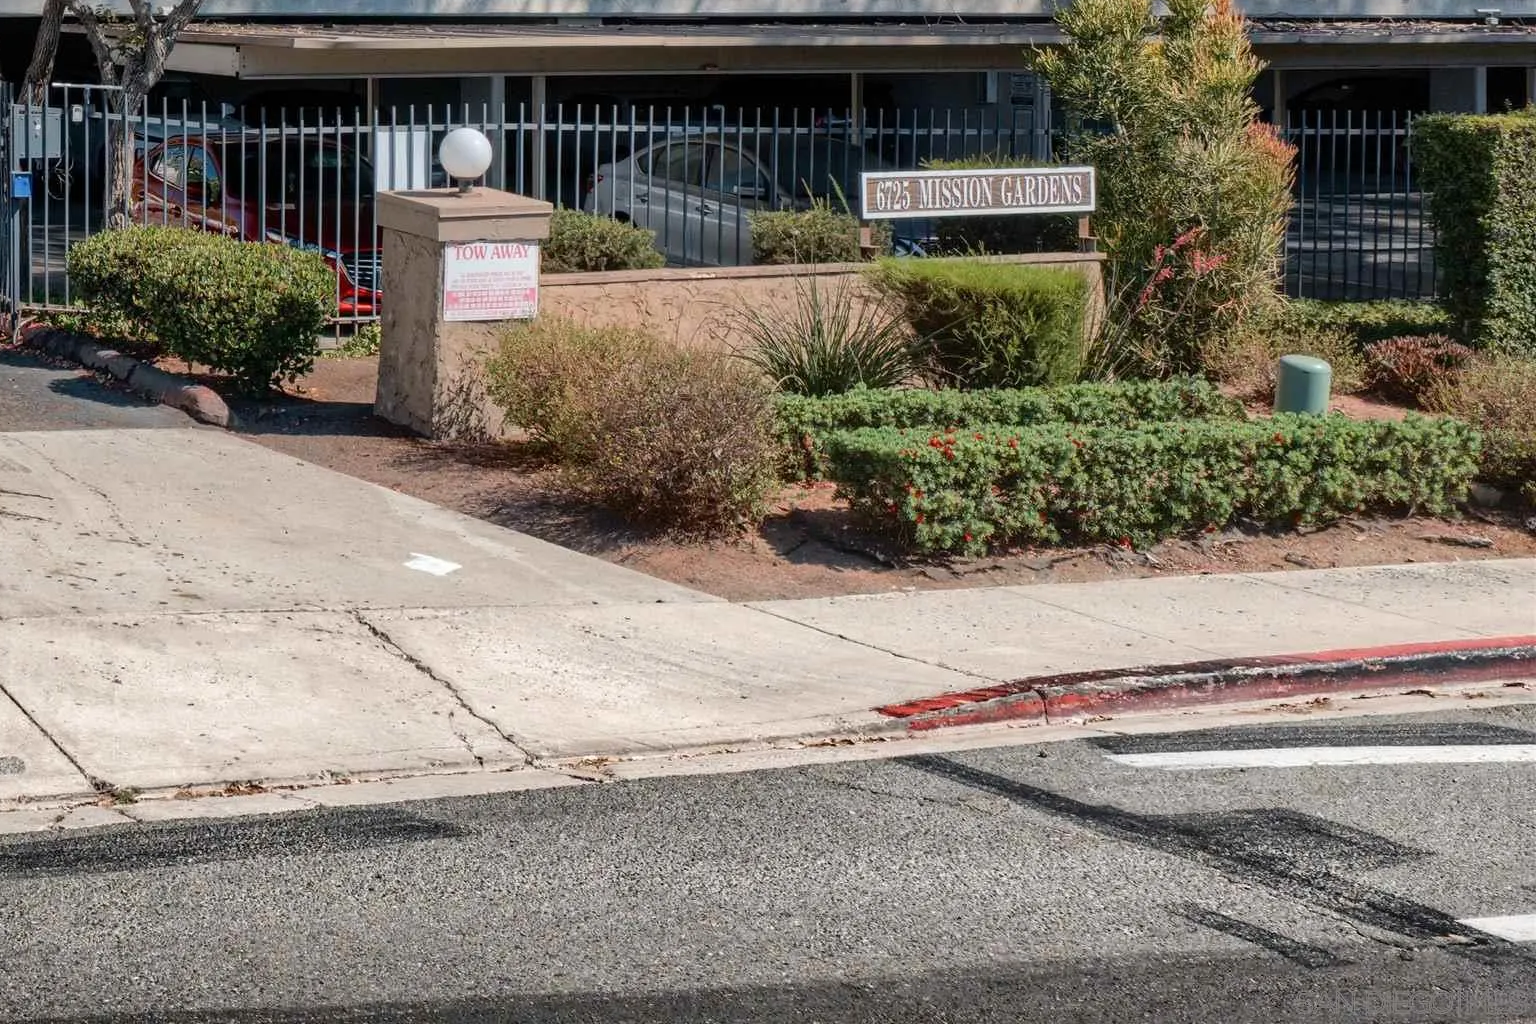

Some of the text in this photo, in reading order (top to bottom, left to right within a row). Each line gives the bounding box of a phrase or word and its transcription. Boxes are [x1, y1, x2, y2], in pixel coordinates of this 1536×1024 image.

[876, 175, 1082, 210] 6725 MISSION GARDENS
[455, 244, 529, 260] TOW AWAY
